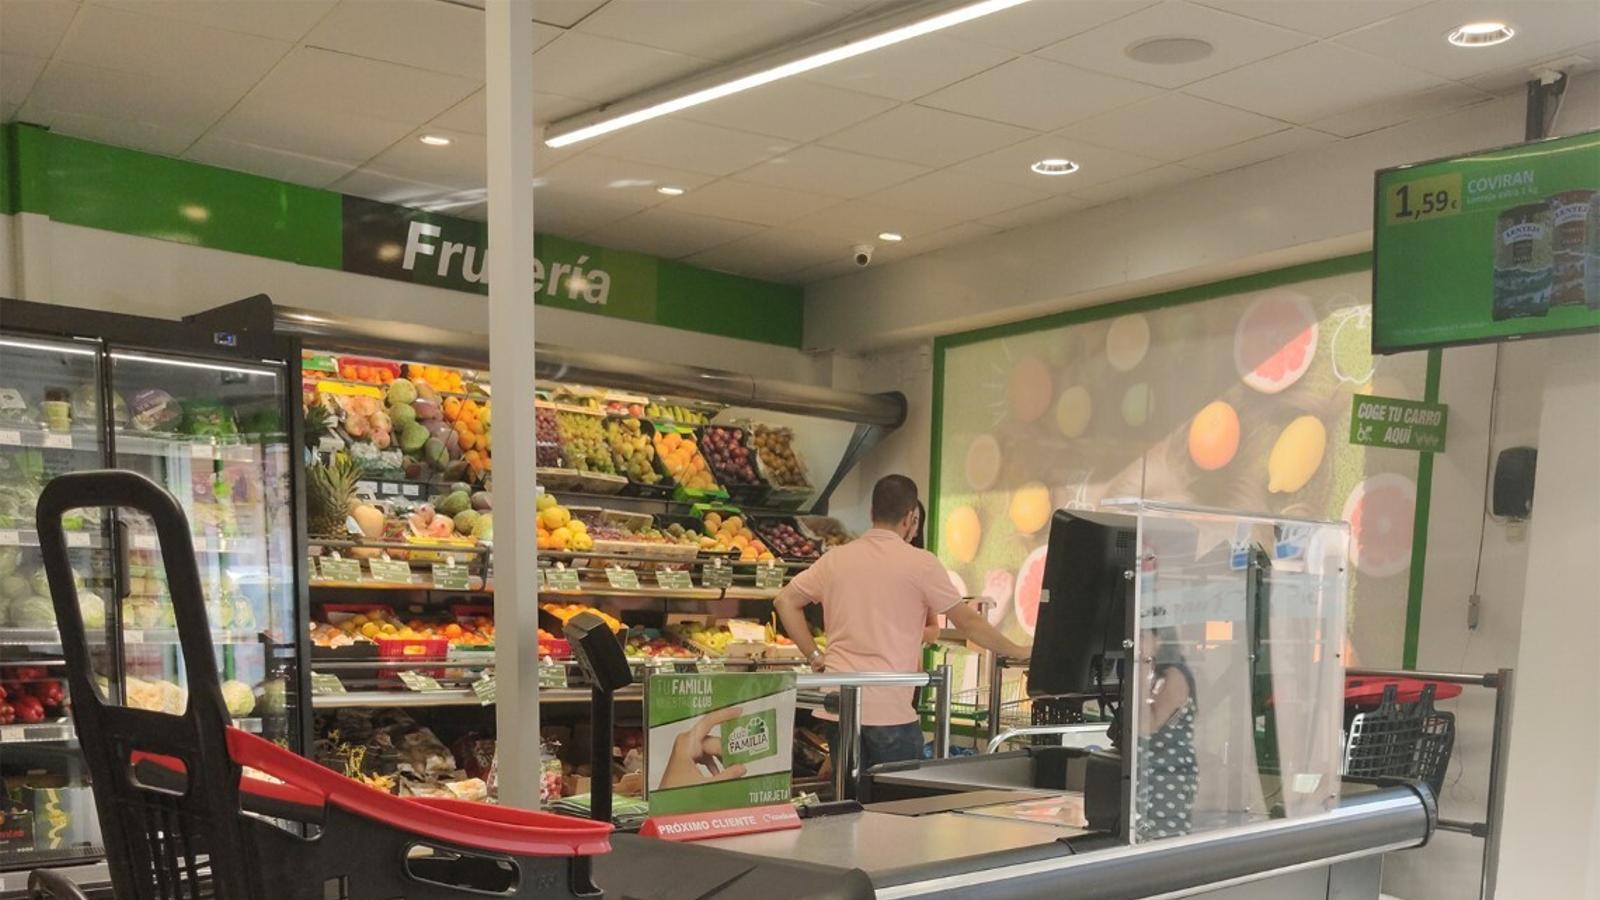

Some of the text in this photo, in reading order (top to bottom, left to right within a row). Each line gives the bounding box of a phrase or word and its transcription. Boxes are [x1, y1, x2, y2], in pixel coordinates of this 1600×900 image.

[1467, 169, 1535, 194] COVIRAN
[402, 220, 611, 305] Fruería
[1358, 402, 1442, 427] COGE TU CARRO
[1384, 425, 1413, 445] AQUÍ
[672, 678, 713, 696] FAMILIA
[729, 733, 768, 752] FAMILIA
[657, 820, 710, 835] PRÓXIMO
[711, 815, 757, 830] CLIENTE
